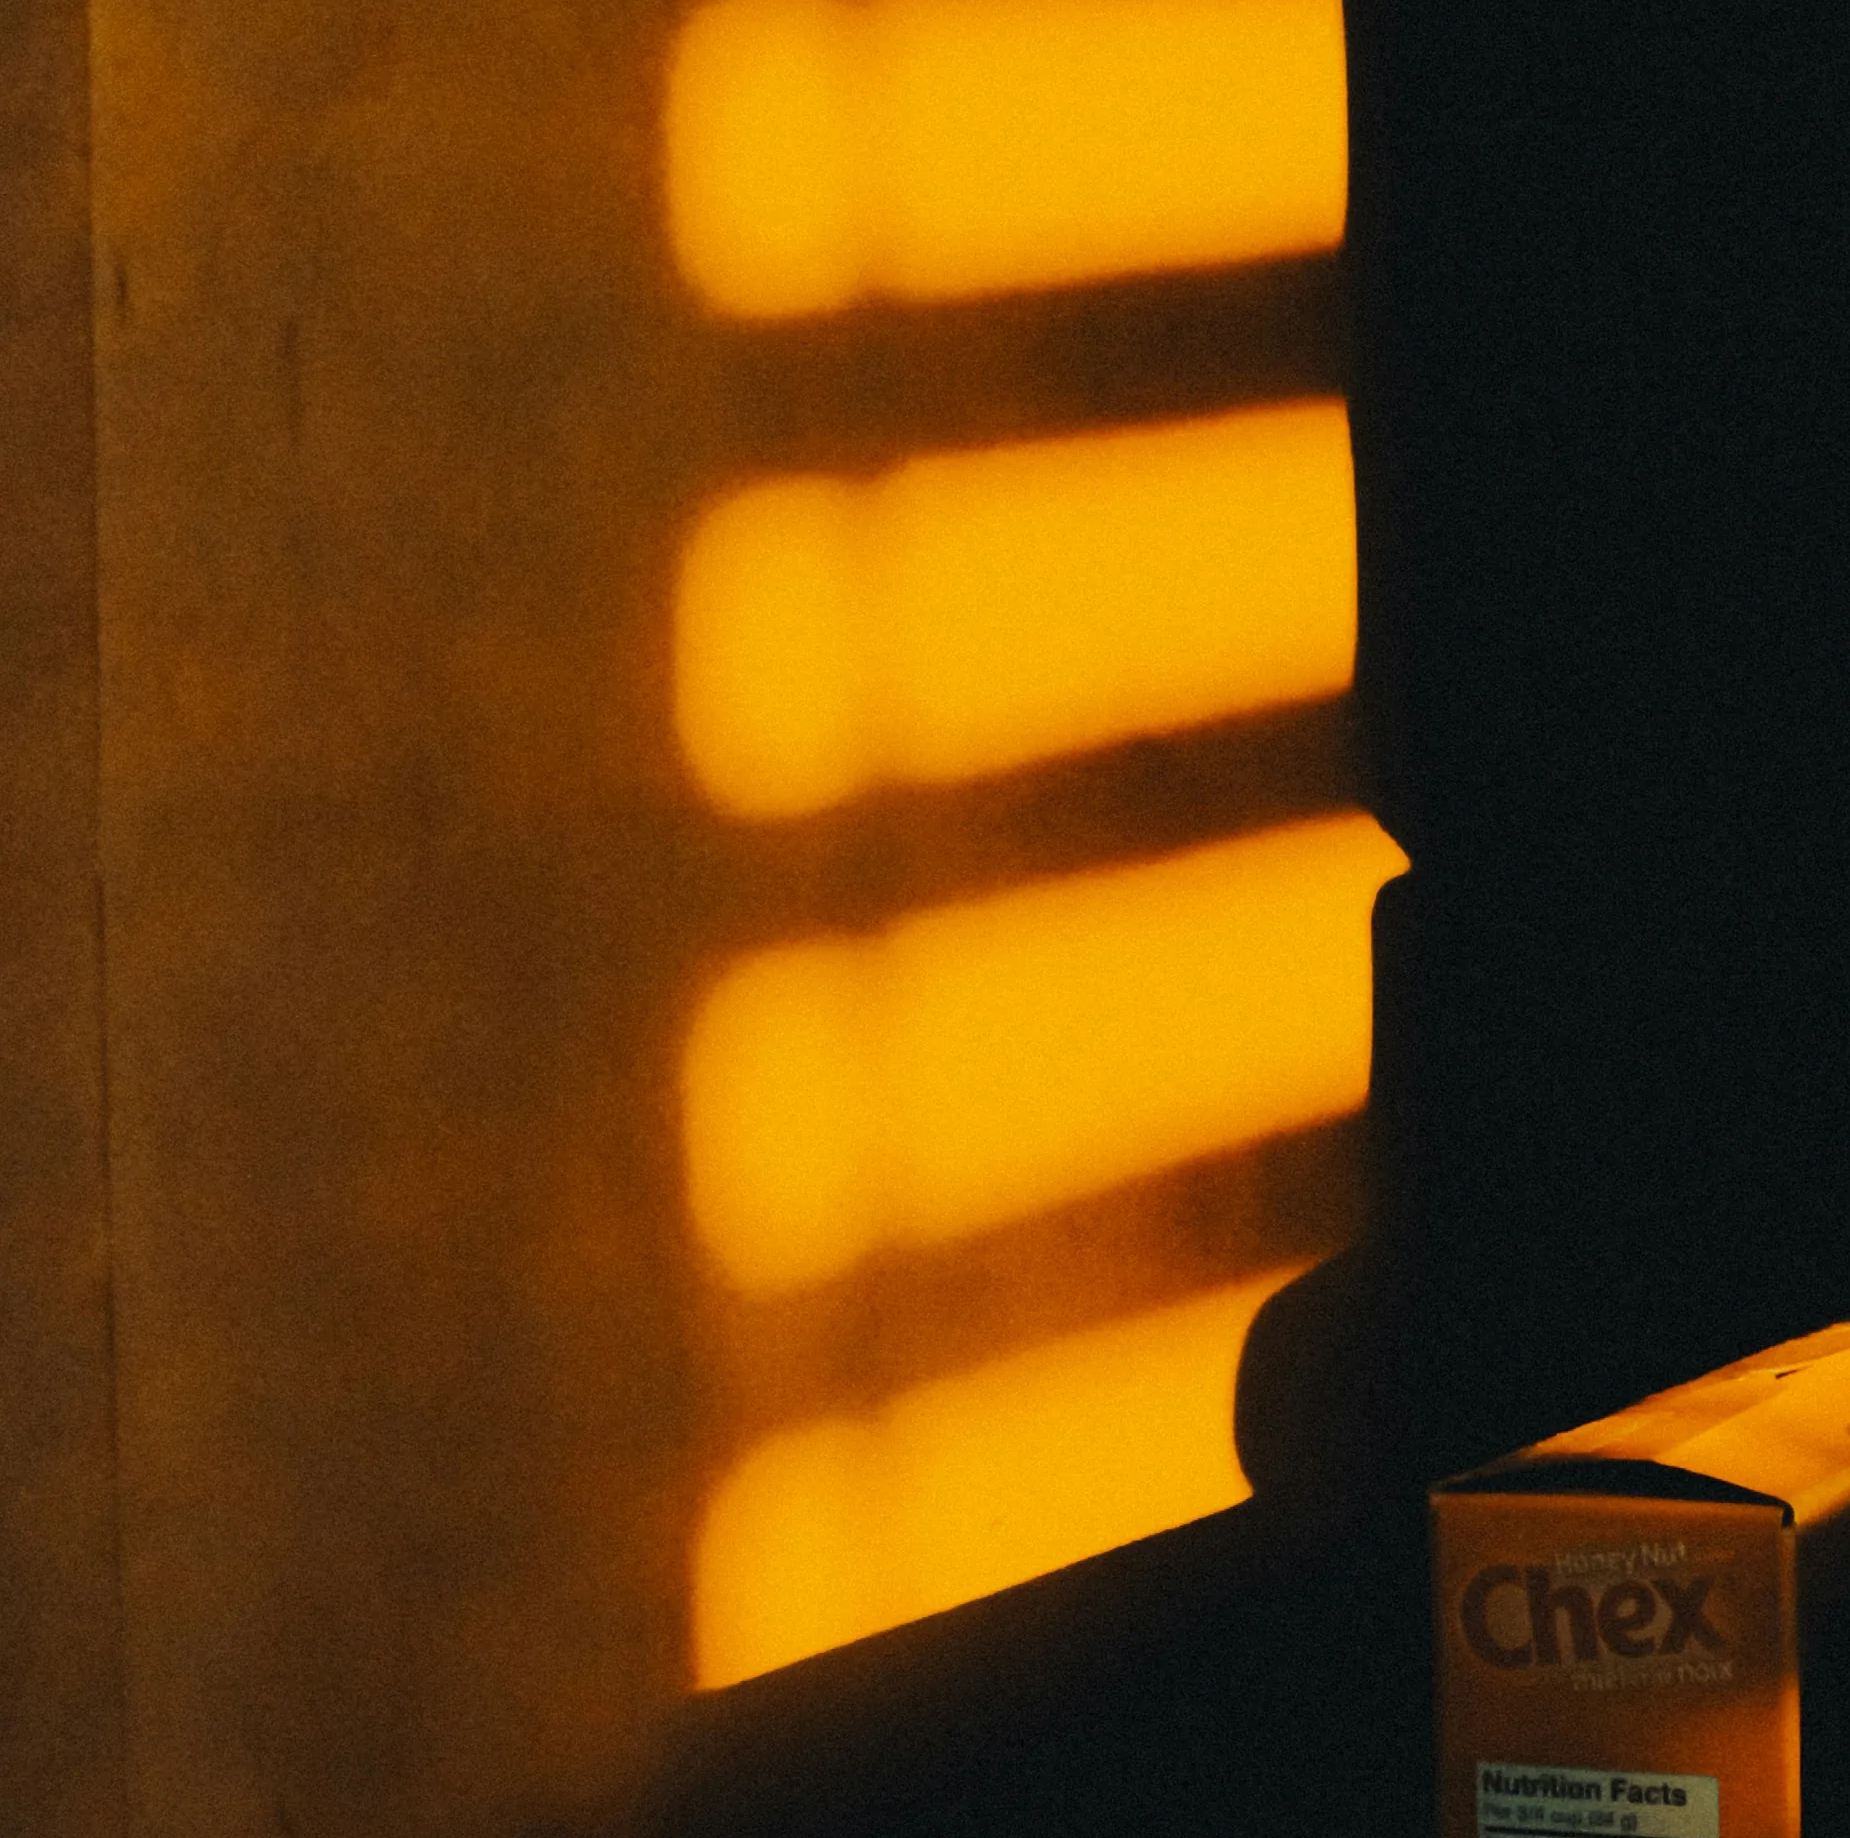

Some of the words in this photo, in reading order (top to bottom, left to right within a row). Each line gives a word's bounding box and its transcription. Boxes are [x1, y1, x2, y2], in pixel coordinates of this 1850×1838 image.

[1461, 1564, 1724, 1670] Chex
[1483, 1770, 1601, 1801] Nutrition
[1611, 1778, 1687, 1806] Facts
